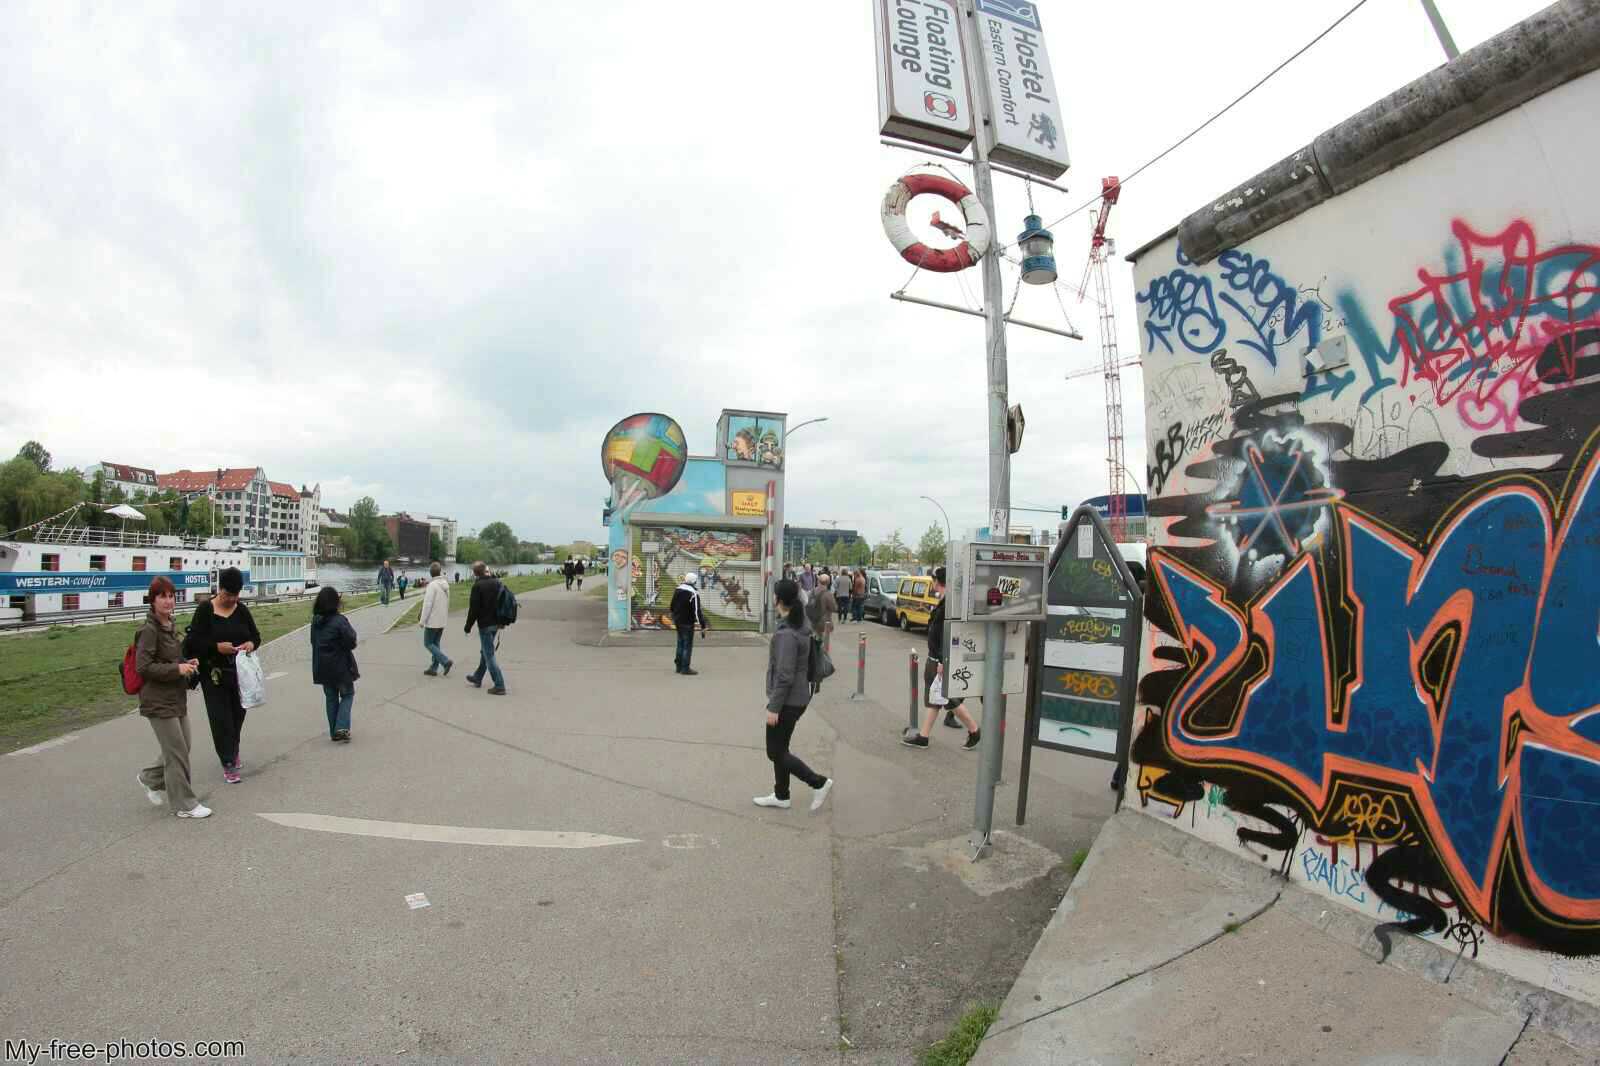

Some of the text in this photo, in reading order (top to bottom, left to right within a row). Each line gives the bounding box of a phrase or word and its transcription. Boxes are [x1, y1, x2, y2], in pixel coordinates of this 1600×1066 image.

[923, 1, 955, 90] Floating
[988, 19, 1019, 126] Eastern Comfort
[1012, 26, 1051, 104] Hostel
[16, 576, 70, 588] WESTERN
[185, 575, 209, 584] HOSTEL
